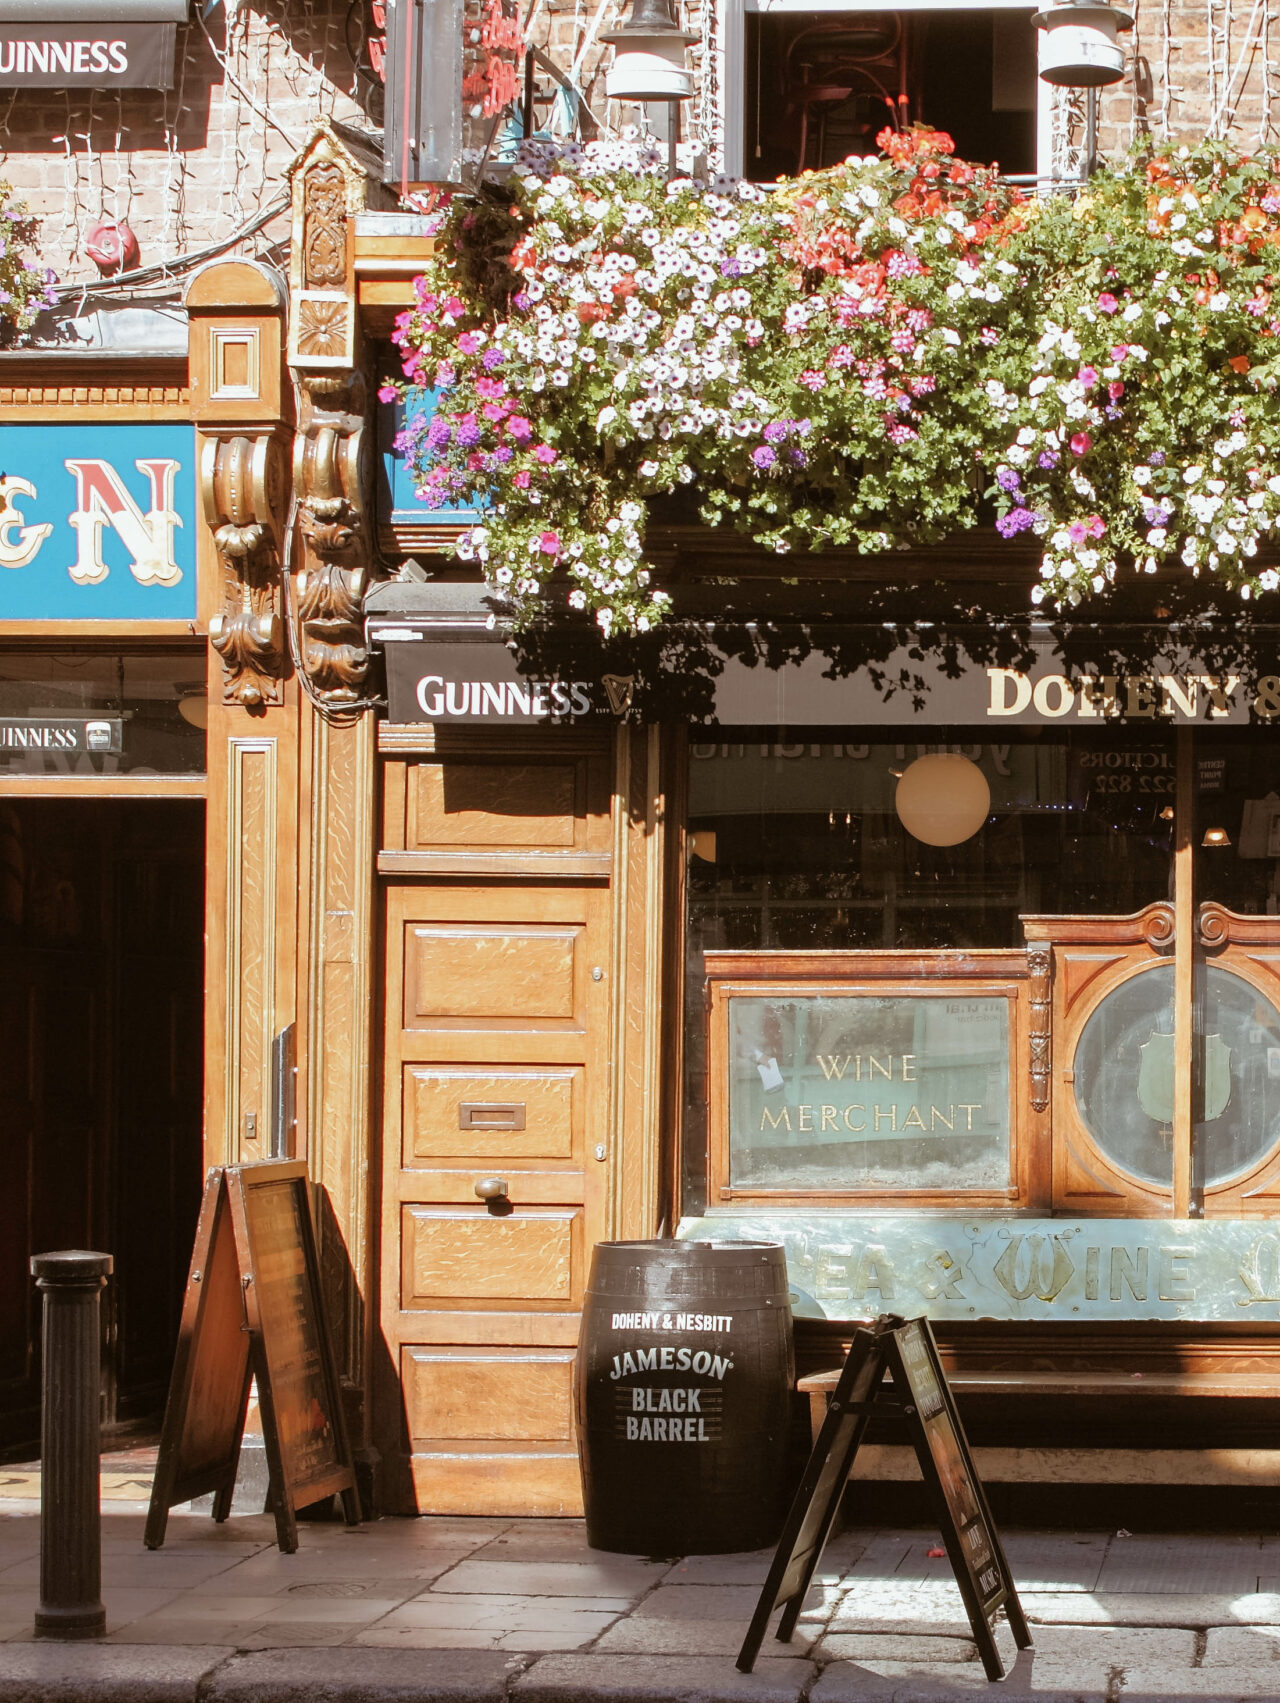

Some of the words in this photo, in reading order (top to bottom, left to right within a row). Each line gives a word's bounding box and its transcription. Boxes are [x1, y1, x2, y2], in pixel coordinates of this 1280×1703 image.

[0, 41, 128, 73] UINNESS
[416, 675, 590, 716] GUINNESS
[986, 668, 1240, 718] DOHENY
[0, 727, 77, 748] INNESS
[816, 1055, 918, 1082] WINE
[760, 1104, 982, 1132] MERCHANT
[914, 1249, 966, 1300] &
[993, 1230, 1196, 1304] WINE
[611, 1312, 660, 1330] DOHENY
[662, 1313, 674, 1330] &
[676, 1314, 733, 1333] NESBITT
[609, 1347, 730, 1381] JAMESON
[632, 1387, 702, 1413] BLACK
[626, 1416, 710, 1442] BARREL
